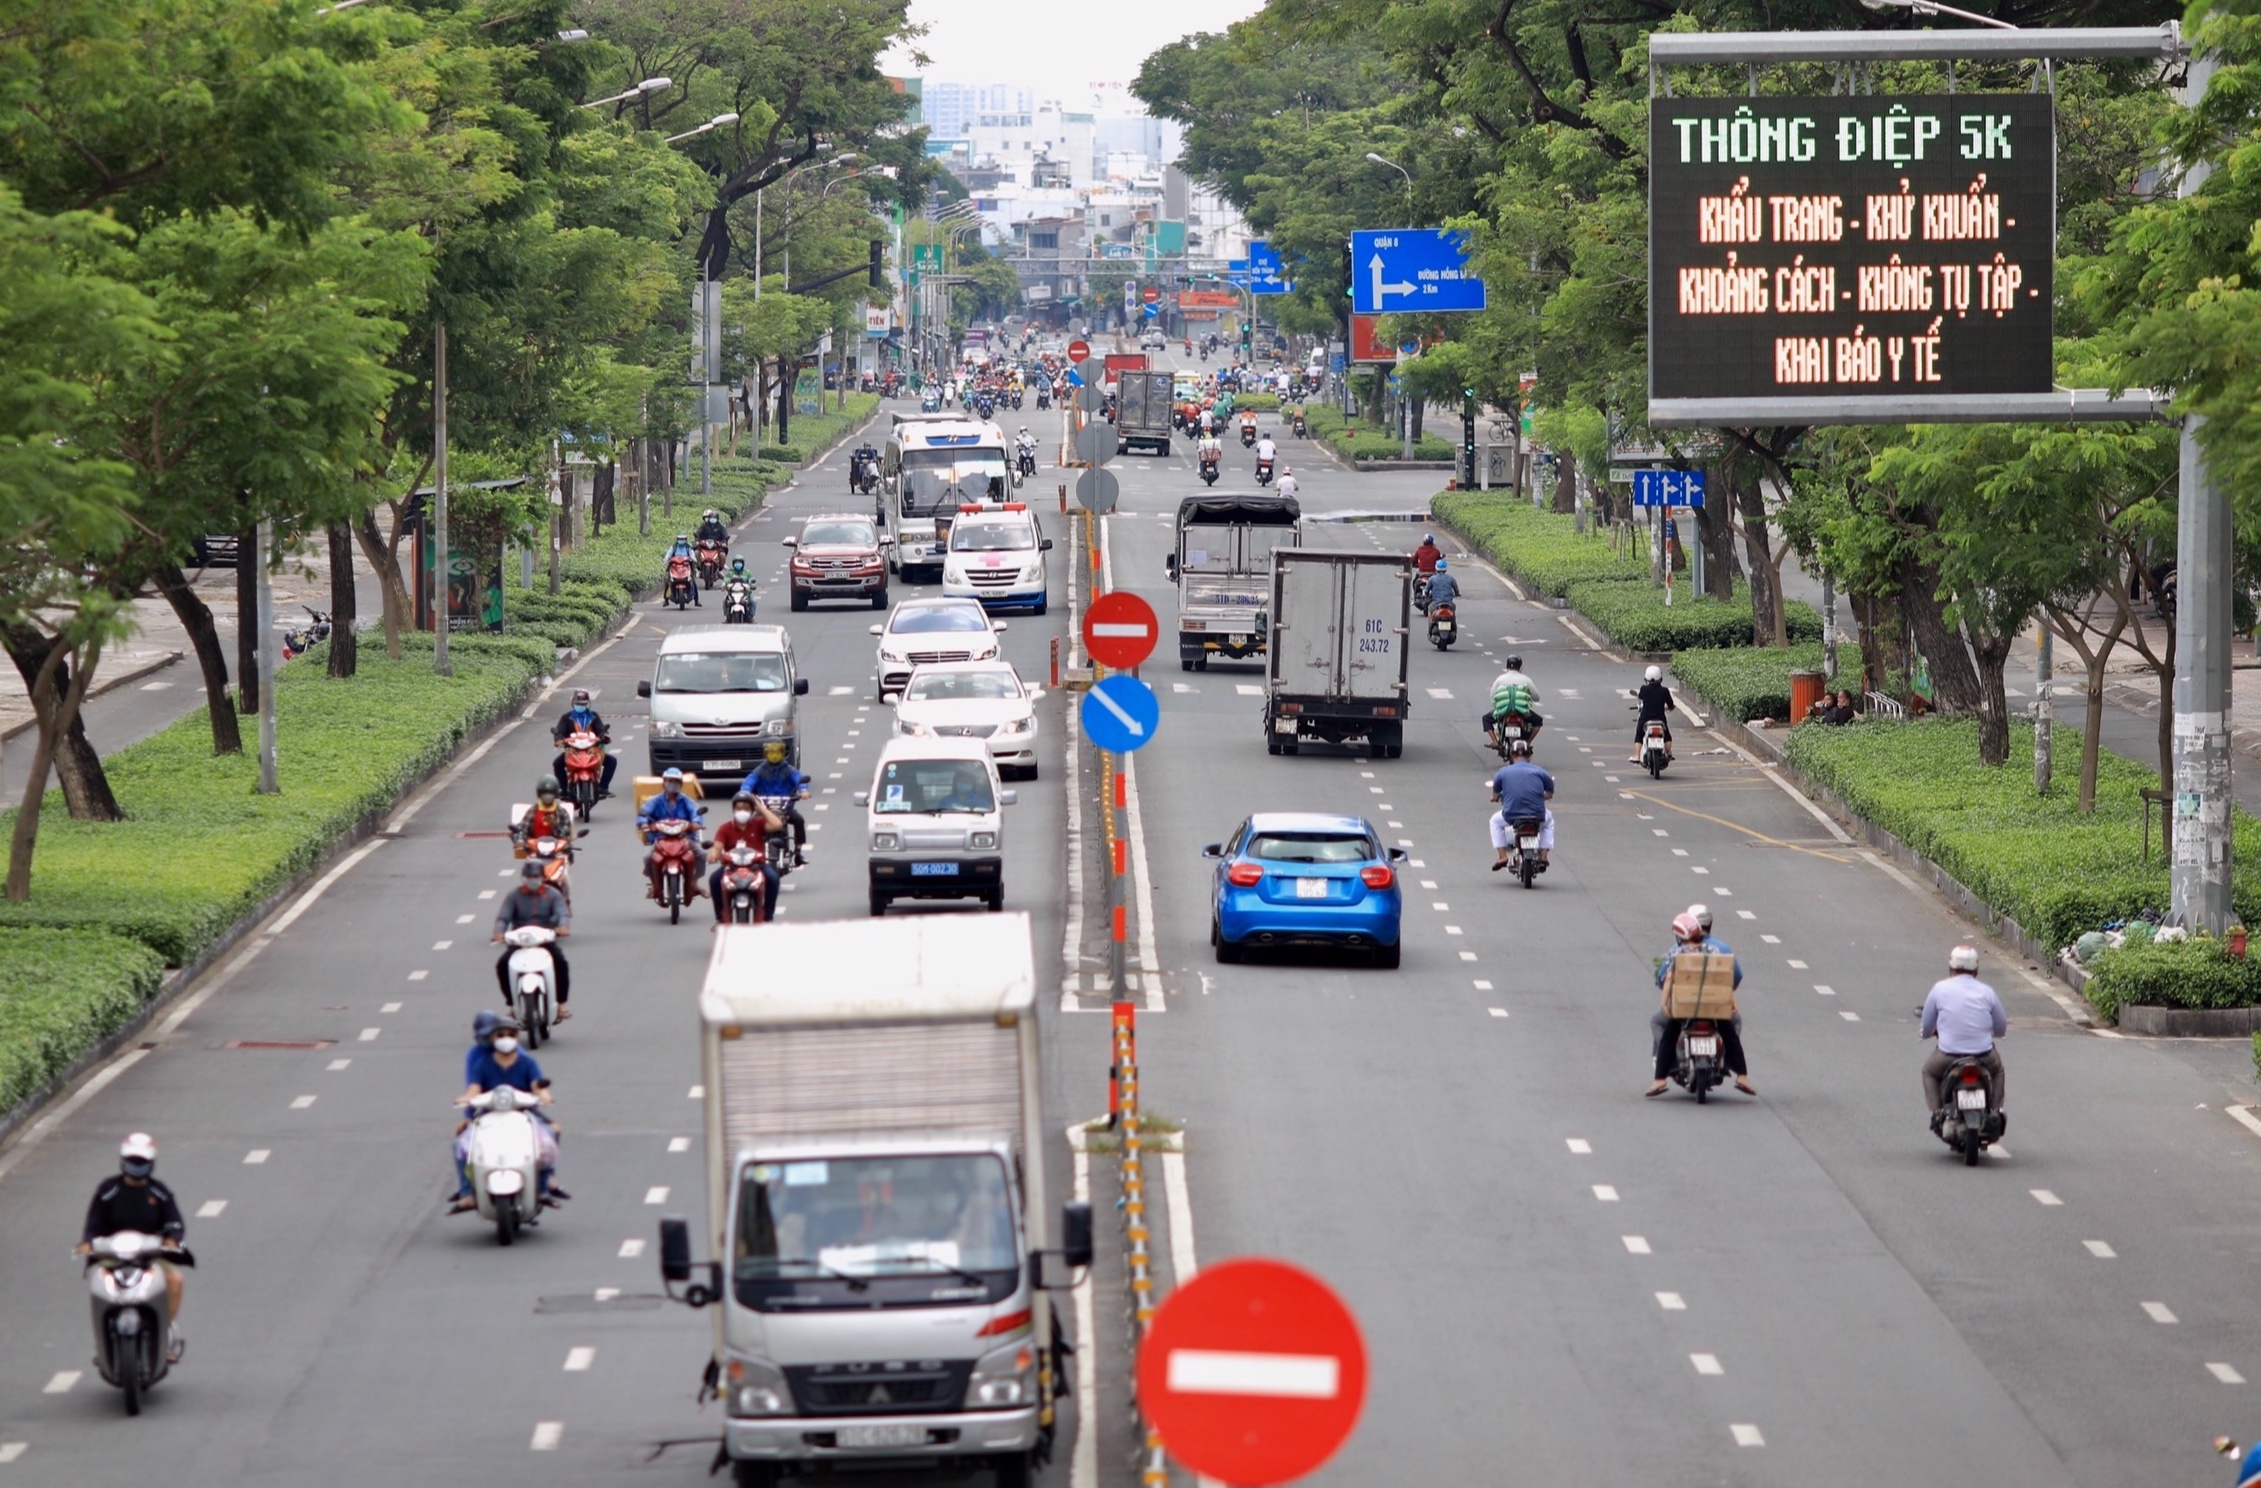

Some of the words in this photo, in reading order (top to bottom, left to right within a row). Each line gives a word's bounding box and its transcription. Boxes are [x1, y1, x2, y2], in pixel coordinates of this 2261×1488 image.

[1672, 106, 1816, 162] THÔNG
[1835, 104, 1940, 168] ĐIỆP
[1960, 115, 2011, 159] 5K
[1700, 176, 1762, 243] KHẨU
[1769, 195, 1842, 242] TRANG
[1866, 178, 1915, 241] KHỬ
[1923, 173, 2000, 240] KHUẨN
[1374, 235, 1392, 250] QUẬN
[1394, 237, 1398, 247] 8
[1418, 268, 1439, 280] ĐƯỜNG
[1441, 266, 1459, 280] HỒNG
[1679, 251, 1768, 314] KHOẢNG
[1775, 254, 1835, 313] CÁCH
[1858, 254, 1932, 311] KHÔNG
[1940, 265, 1970, 318] TỤ
[1978, 252, 2021, 318] TẬP
[1775, 337, 1829, 383] KHAI
[1836, 324, 1881, 382] BÁO
[1888, 337, 1903, 382] Y
[1911, 316, 1942, 382] TẾ
[1359, 638, 1389, 653] 243.72
[1365, 619, 1382, 633] 61C
